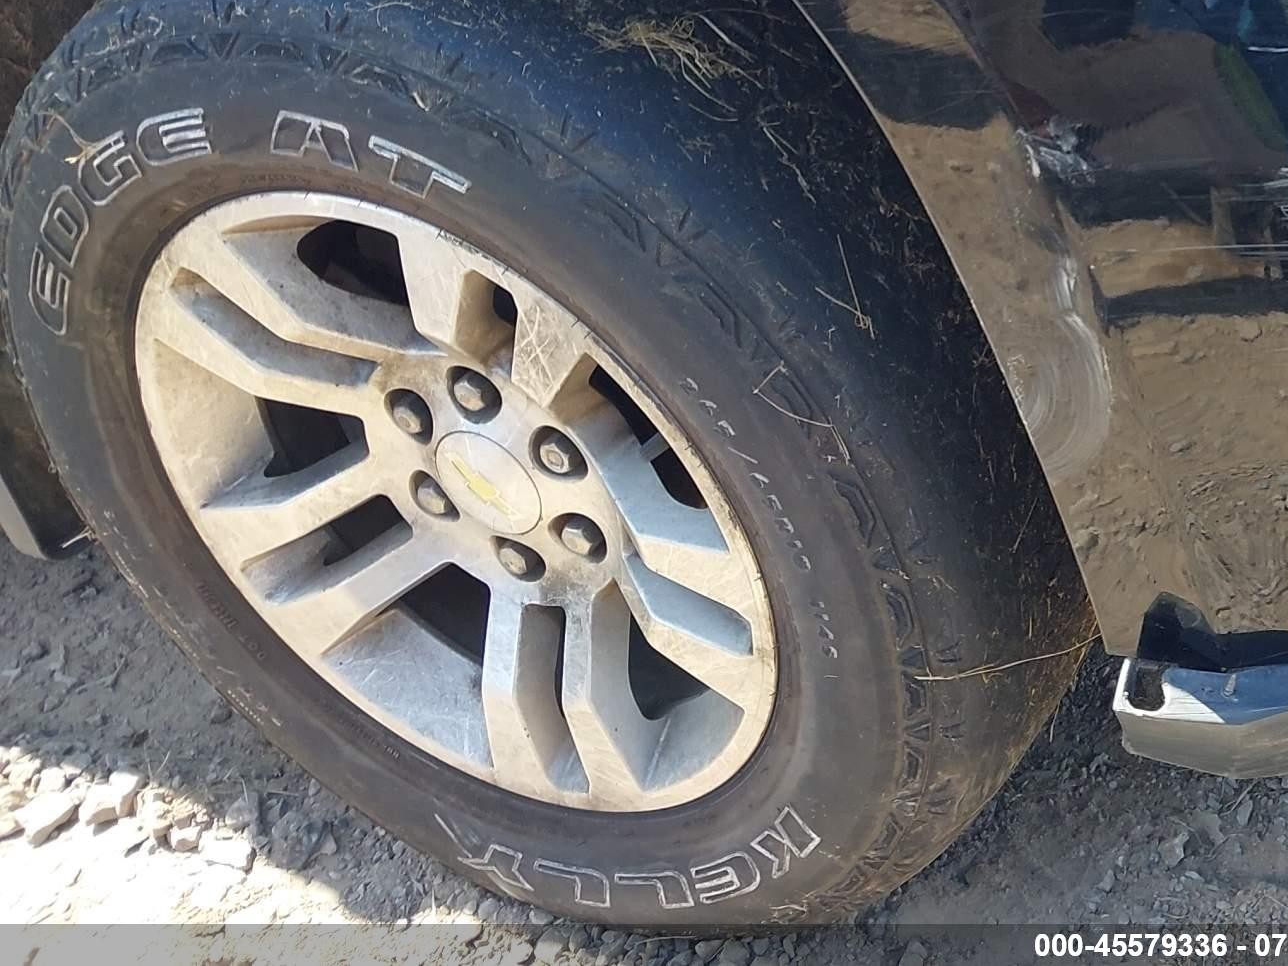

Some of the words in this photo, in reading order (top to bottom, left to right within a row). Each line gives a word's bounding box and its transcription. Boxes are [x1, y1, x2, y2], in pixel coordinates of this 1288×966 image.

[28, 106, 213, 336] EDGE
[269, 109, 473, 199] AT
[433, 803, 821, 910] KELLY
